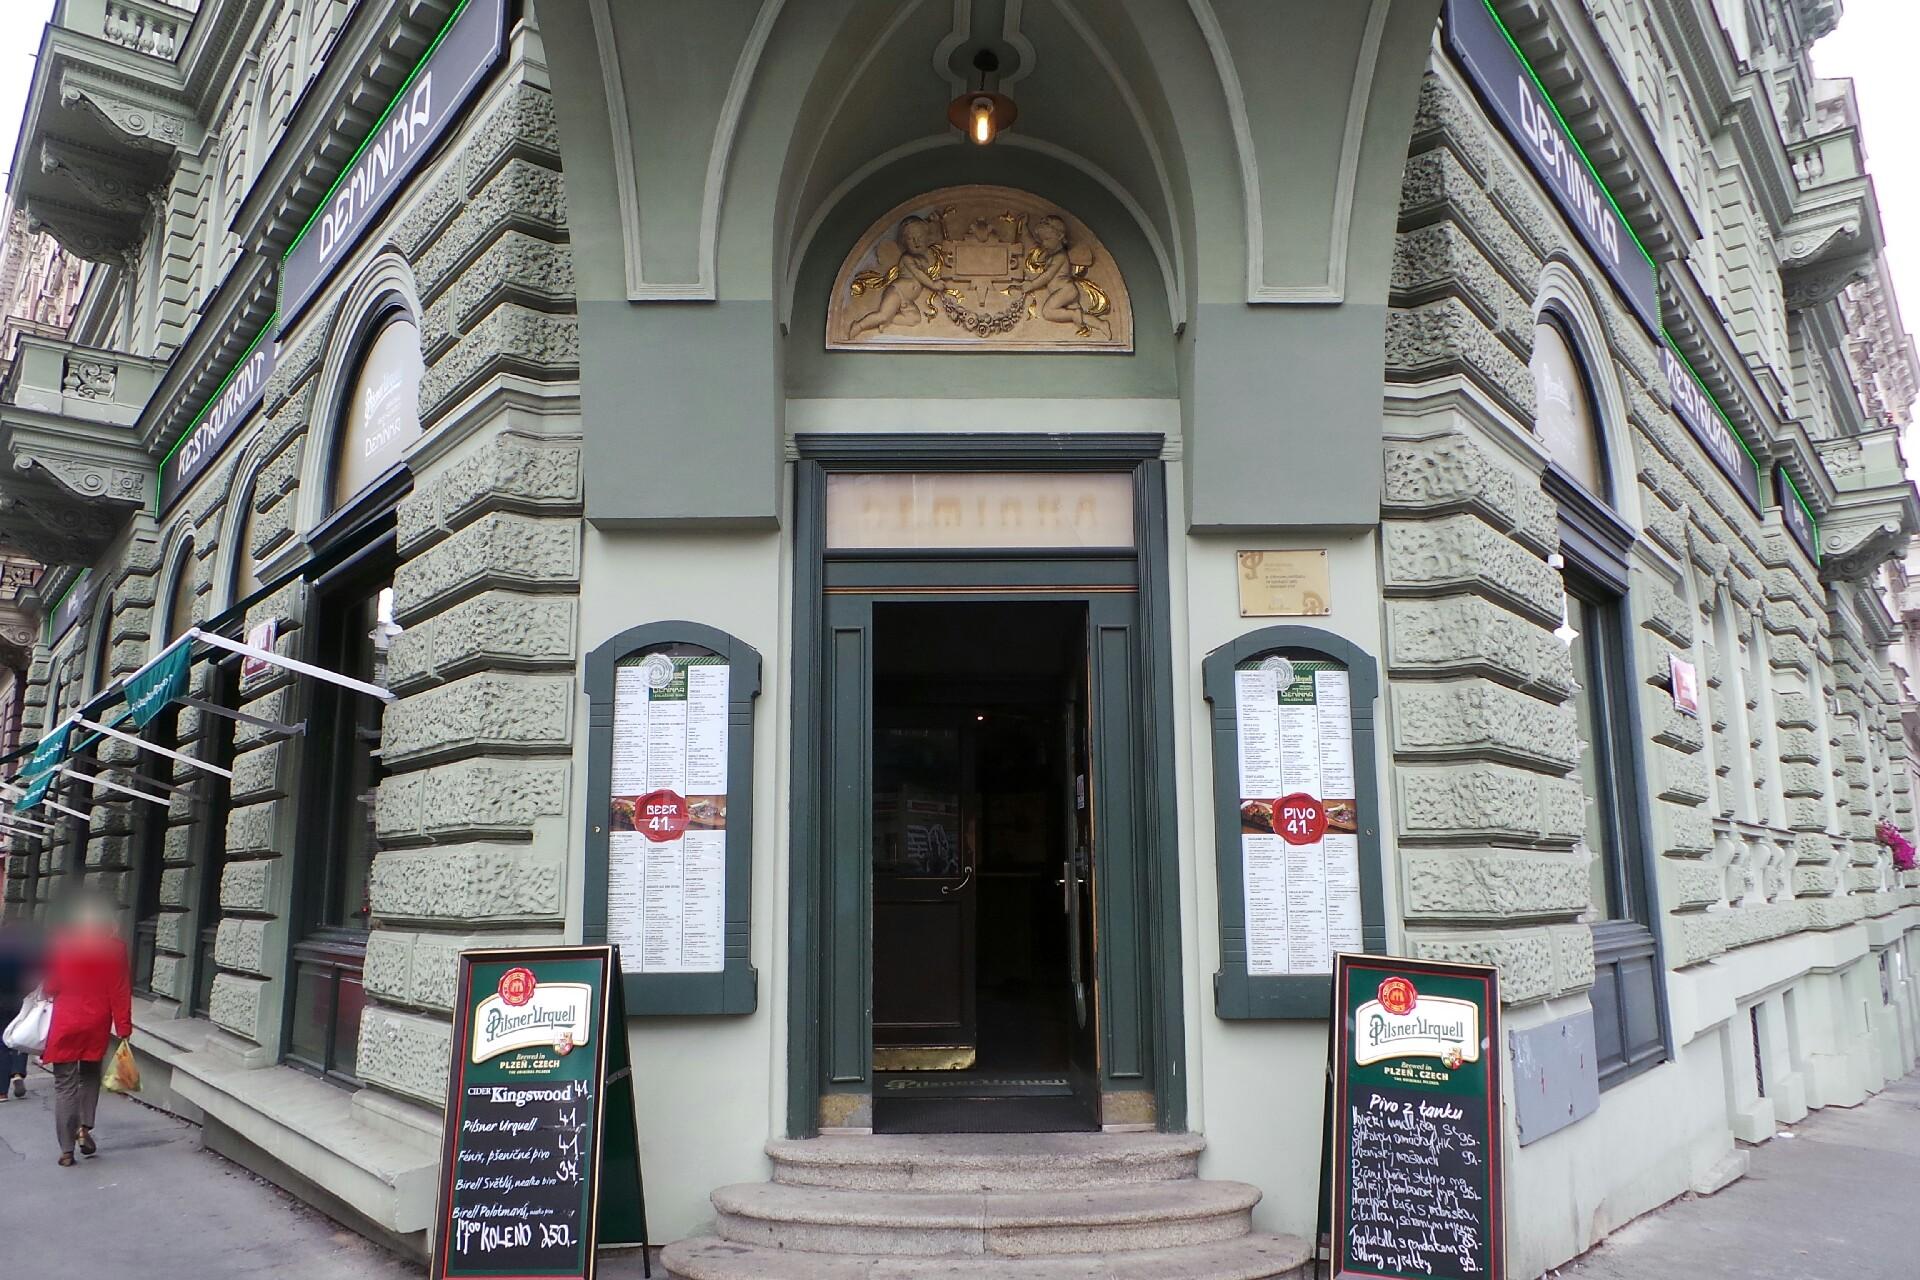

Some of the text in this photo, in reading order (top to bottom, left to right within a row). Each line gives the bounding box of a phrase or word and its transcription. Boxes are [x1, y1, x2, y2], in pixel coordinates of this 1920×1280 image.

[320, 71, 432, 263] DEMINKA
[1518, 75, 1620, 264] DEMINKA
[178, 352, 264, 481] RESTAURANT
[1665, 347, 1742, 475] RESTAURANT
[647, 805, 677, 815] BEER
[1284, 808, 1316, 819] PIVO
[486, 1005, 576, 1042] Pilsner Urquell
[1369, 1014, 1464, 1046] Pilsner Urquell
[533, 1060, 560, 1068] CZECH
[1419, 1071, 1449, 1081] CZECH
[468, 1087, 491, 1095] CIDER
[490, 1085, 571, 1107] Kingswood
[1369, 1094, 1398, 1113] Pivo
[1419, 1100, 1463, 1120] tanku
[463, 1119, 498, 1133] Pilsner
[499, 1117, 538, 1136] Urquell
[455, 1177, 481, 1190] Birell
[481, 1221, 532, 1252] KOLENO
